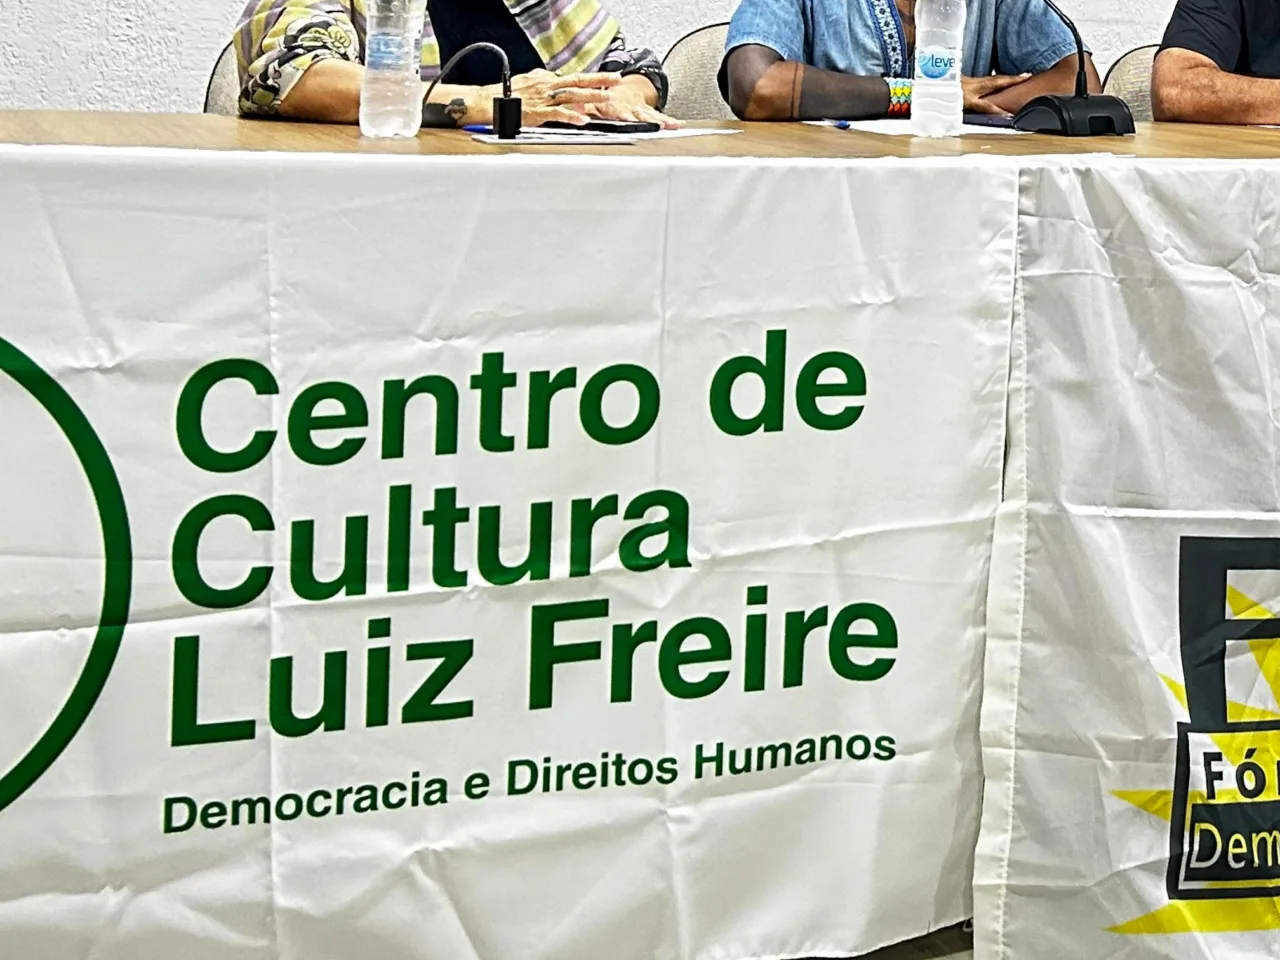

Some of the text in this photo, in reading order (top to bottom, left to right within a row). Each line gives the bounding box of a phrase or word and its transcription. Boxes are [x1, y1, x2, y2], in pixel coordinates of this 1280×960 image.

[931, 54, 956, 68] leve
[176, 328, 867, 473] Centro de
[171, 484, 692, 609] Cultura
[169, 585, 898, 748] Luiz Freire
[163, 728, 897, 834] Democracia e Direitos Humanos
